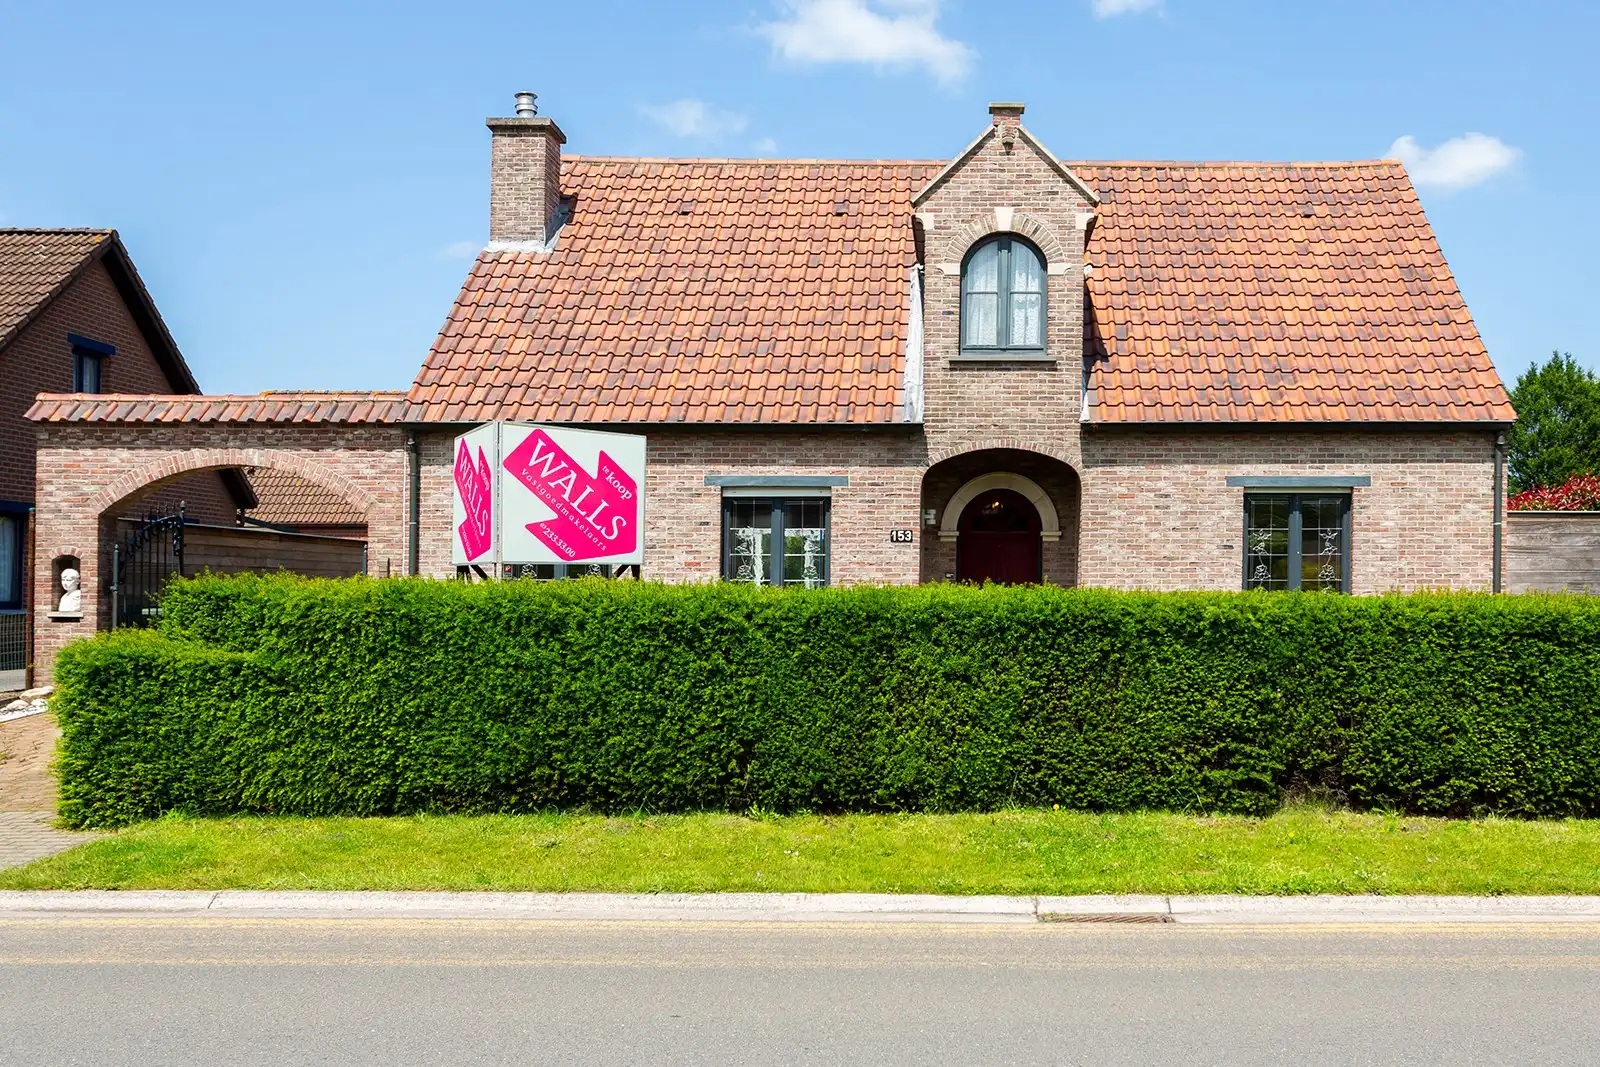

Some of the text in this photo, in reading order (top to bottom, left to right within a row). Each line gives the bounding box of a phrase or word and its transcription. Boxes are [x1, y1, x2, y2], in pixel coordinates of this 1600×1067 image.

[460, 446, 488, 536] WALLS
[521, 468, 607, 551] vastgoedmakelaars
[527, 438, 627, 541] WALLS
[891, 530, 912, 541] 153
